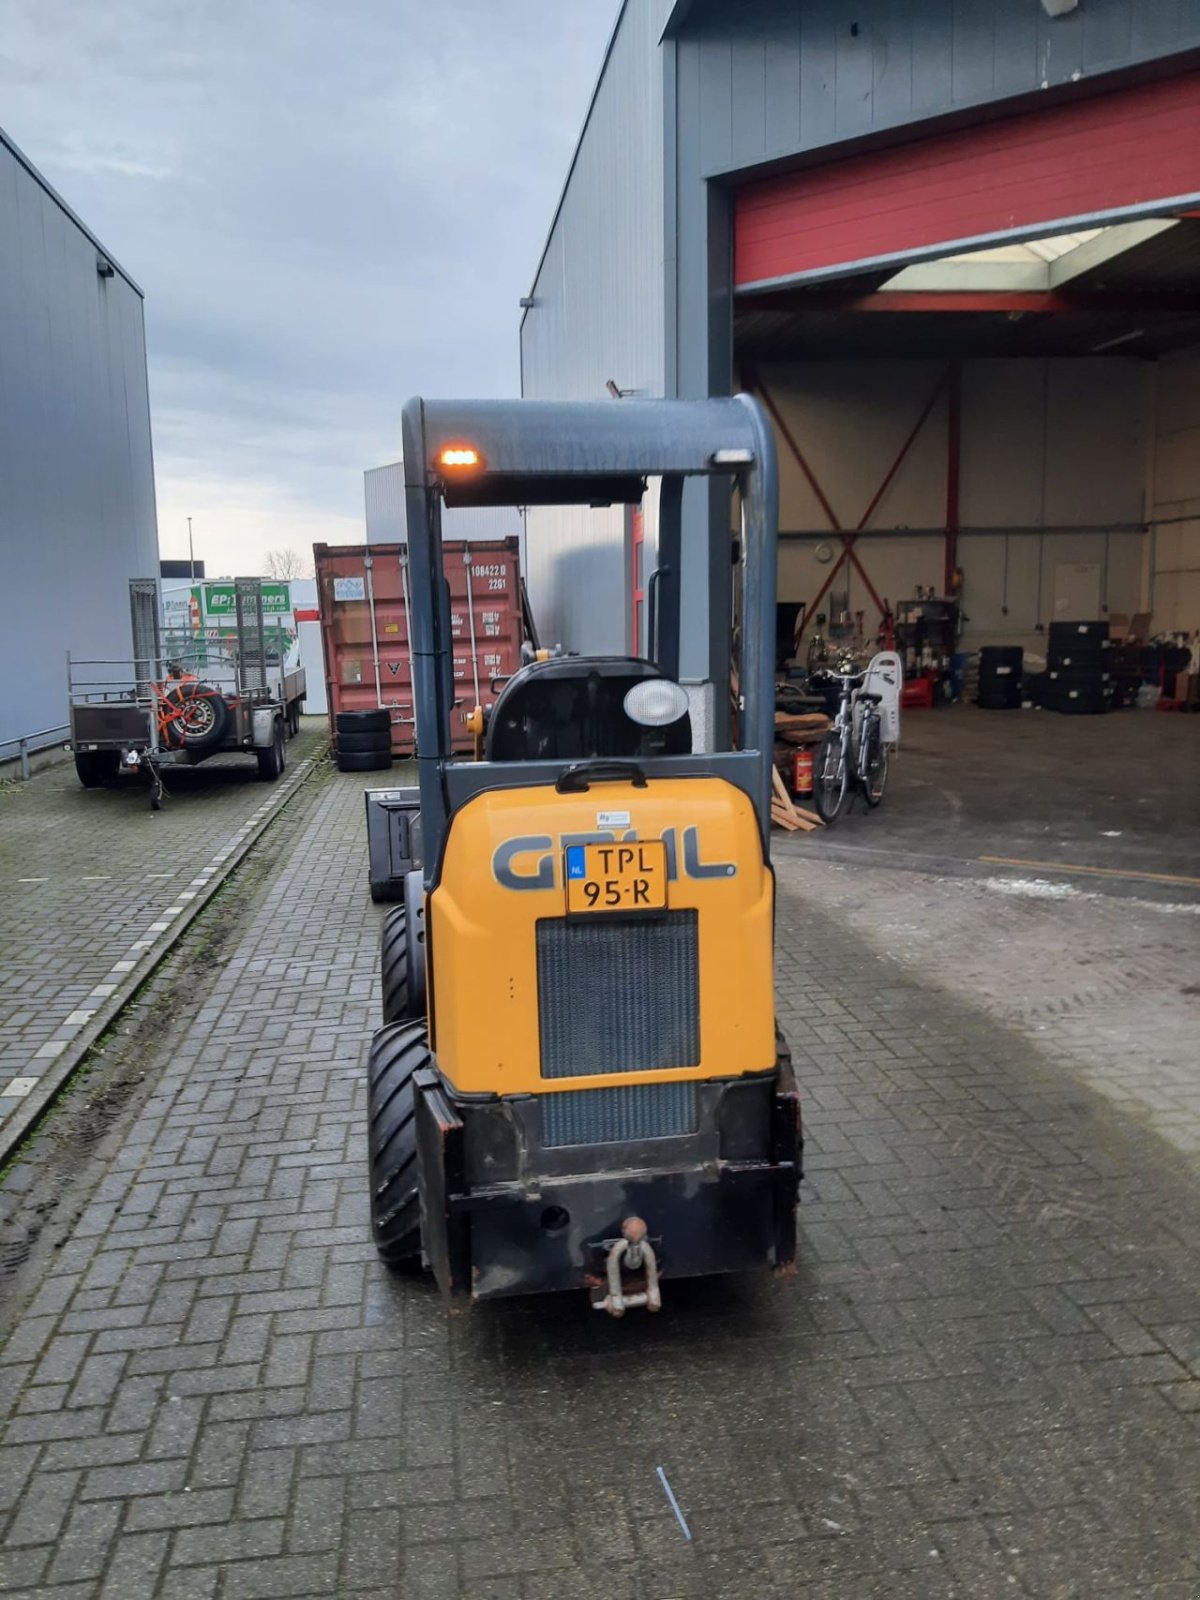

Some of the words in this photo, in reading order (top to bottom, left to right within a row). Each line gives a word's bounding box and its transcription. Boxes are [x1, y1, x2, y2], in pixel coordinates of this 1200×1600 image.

[492, 824, 737, 891] GL
[571, 866, 583, 875] NL
[598, 847, 654, 875] TPL
[583, 879, 651, 907] 95-R
